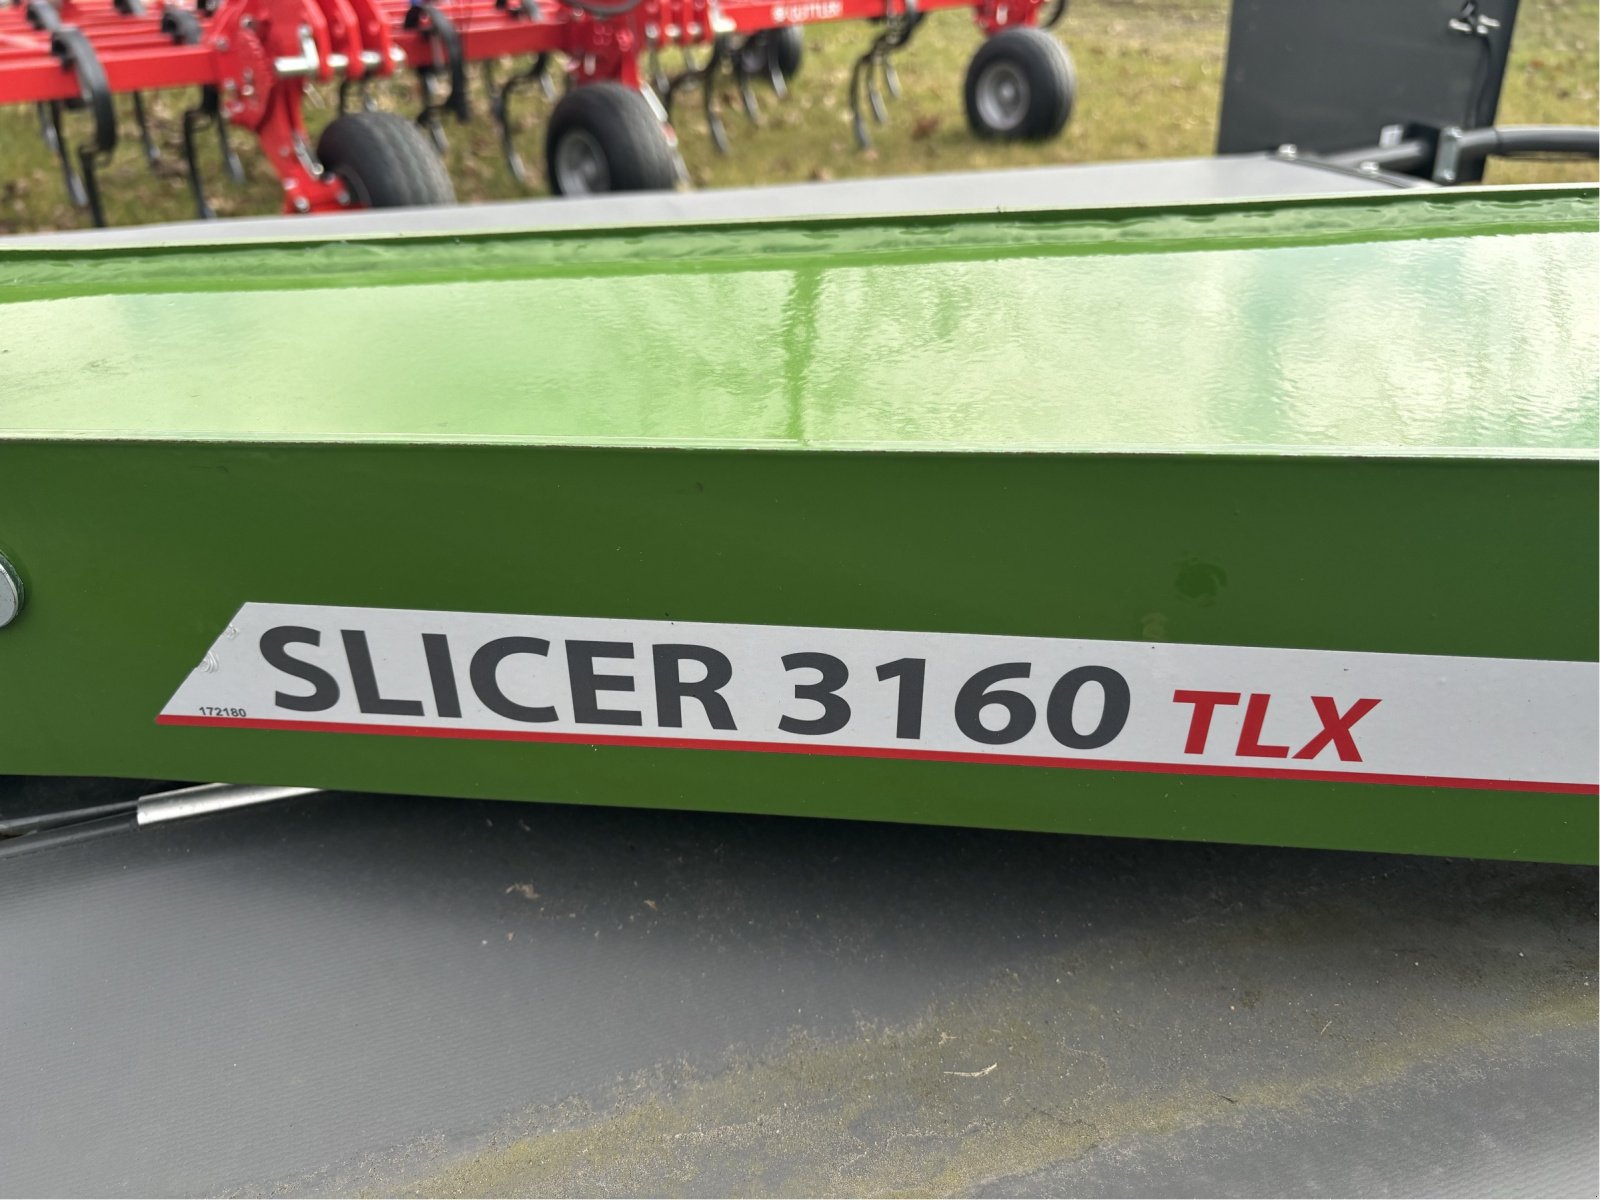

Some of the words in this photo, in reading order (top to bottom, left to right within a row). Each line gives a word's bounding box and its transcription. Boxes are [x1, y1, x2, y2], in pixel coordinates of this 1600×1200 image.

[199, 706, 247, 718] 172180
[259, 626, 738, 731] SLICER
[778, 652, 1132, 750] 3160
[1173, 690, 1382, 763] TLX
